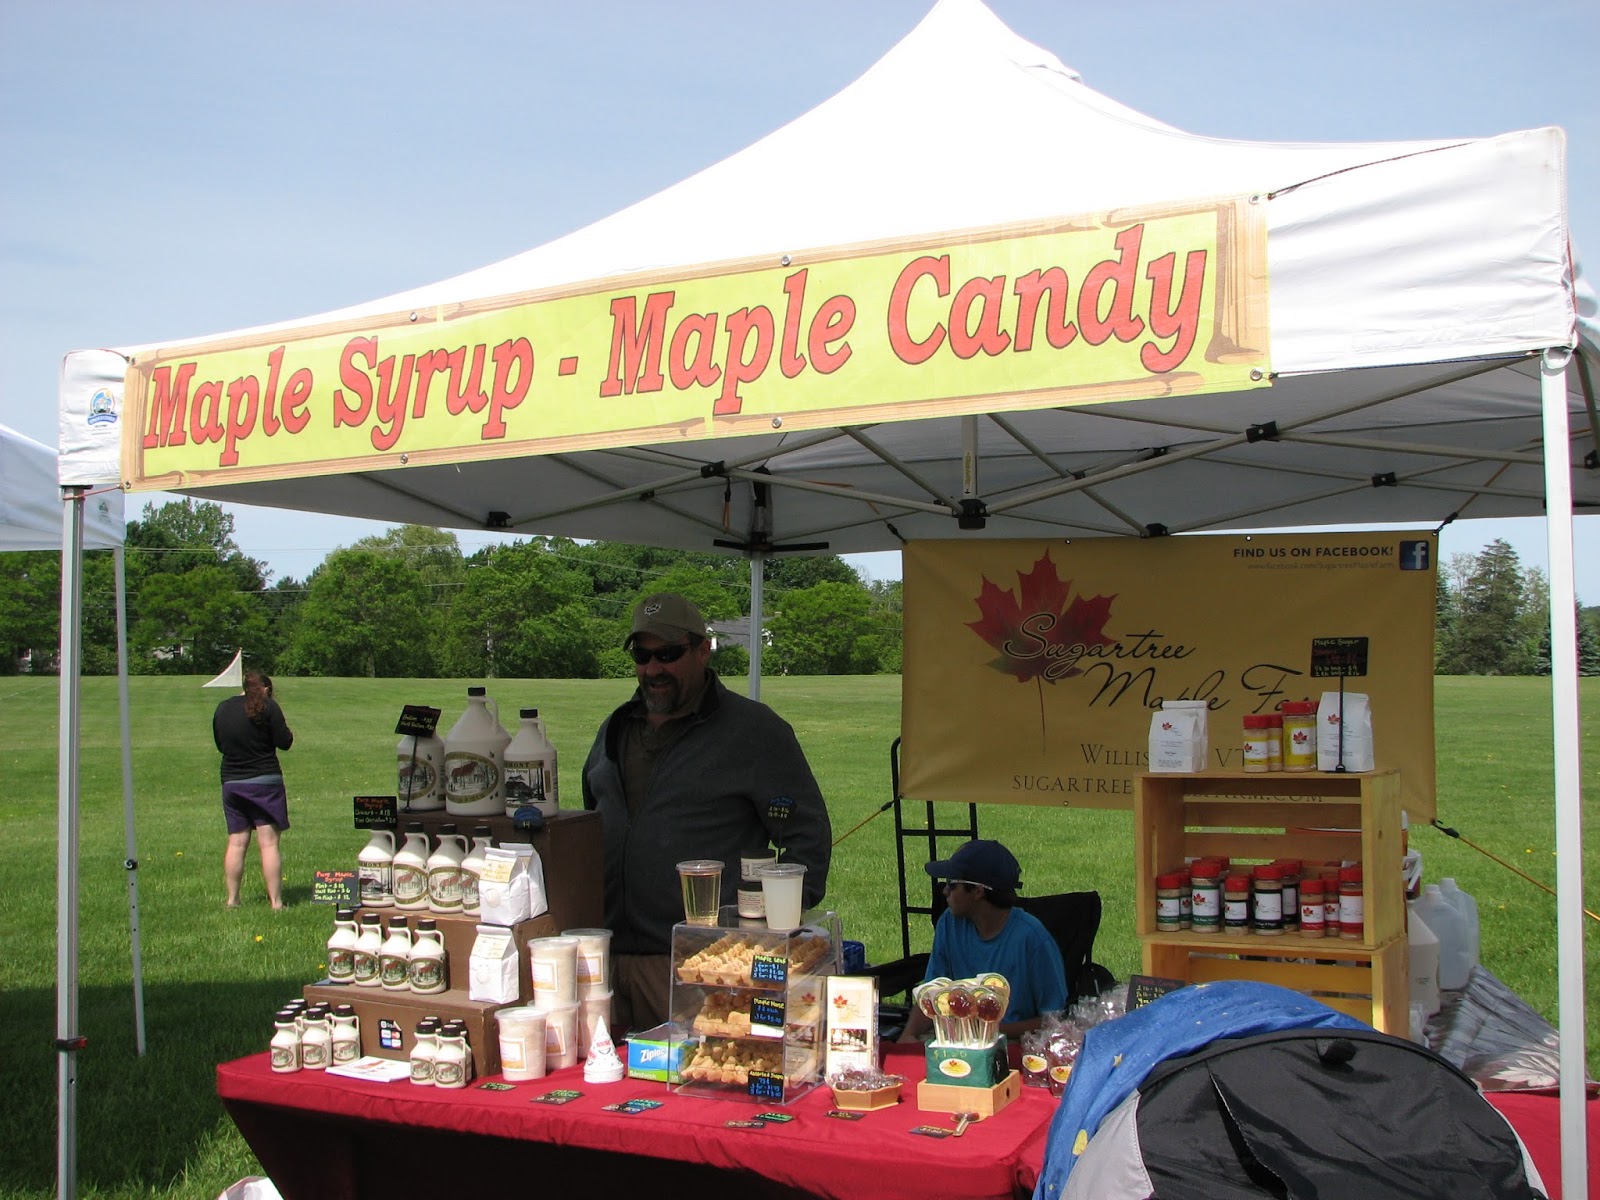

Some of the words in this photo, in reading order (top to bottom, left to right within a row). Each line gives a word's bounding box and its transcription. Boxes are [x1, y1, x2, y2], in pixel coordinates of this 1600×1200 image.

[143, 346, 313, 467] Maple
[334, 336, 534, 451] Syrup
[600, 268, 857, 416] Maple
[887, 223, 1208, 373] Candy
[1233, 547, 1265, 558] FIND
[1269, 547, 1287, 558] US
[1290, 547, 1311, 557] ON
[1315, 546, 1394, 557] FACEBOOK!
[1003, 612, 1197, 680] Sugartree
[640, 1047, 669, 1063] Ziploc
